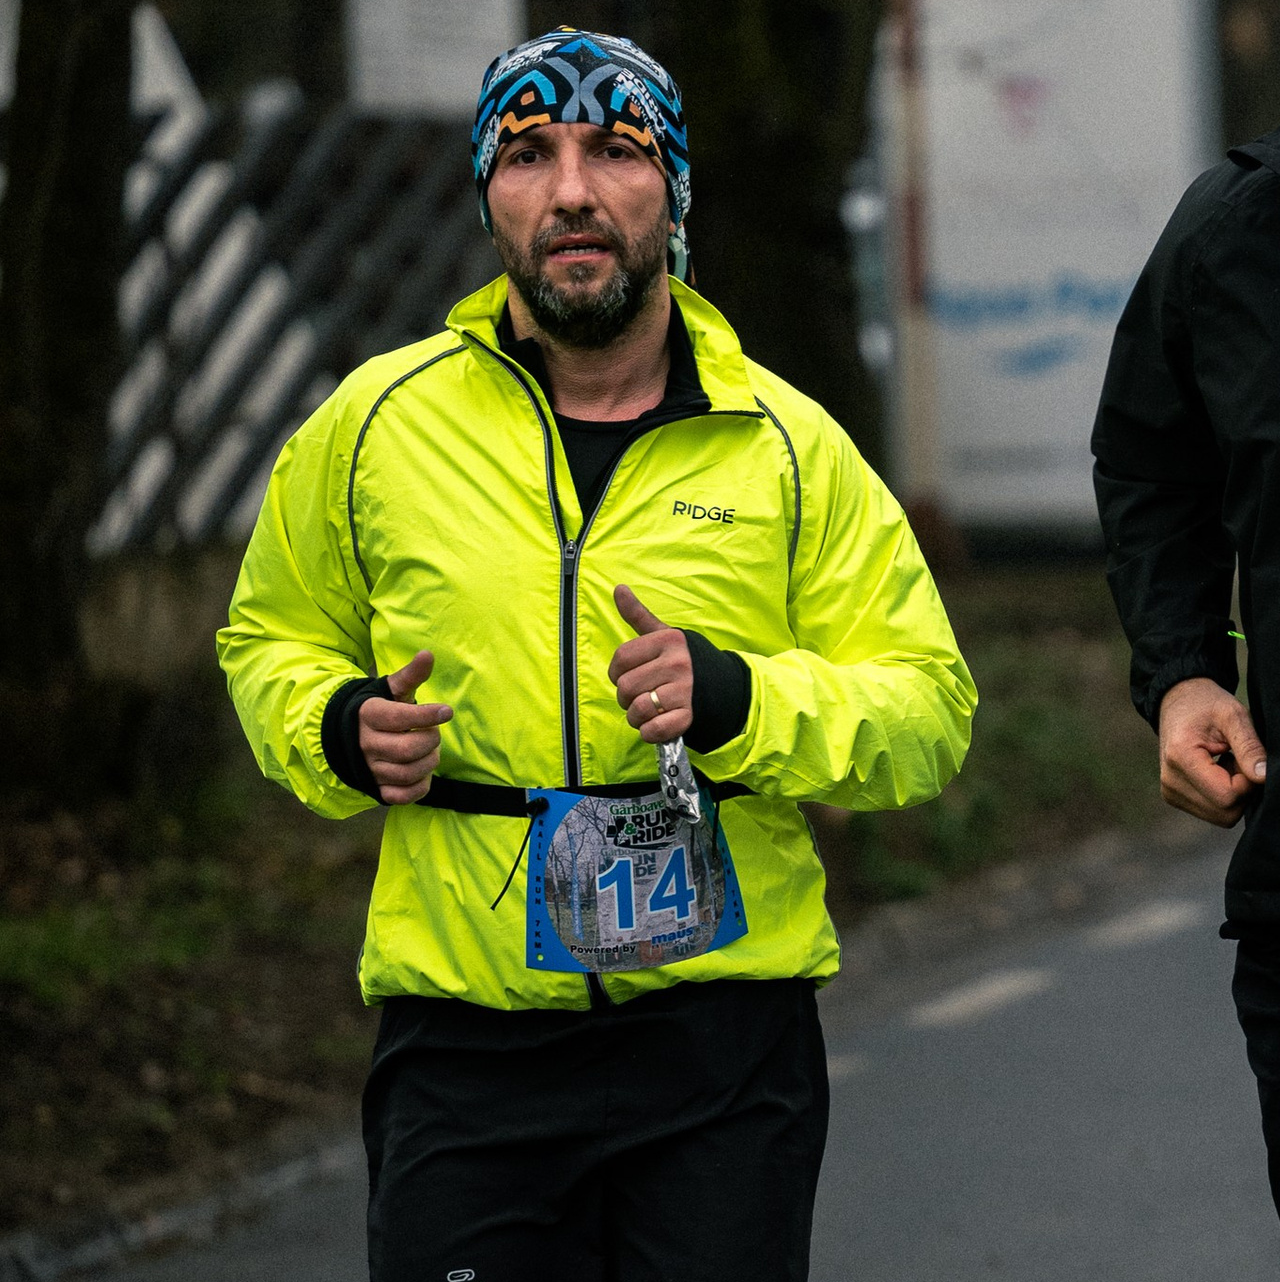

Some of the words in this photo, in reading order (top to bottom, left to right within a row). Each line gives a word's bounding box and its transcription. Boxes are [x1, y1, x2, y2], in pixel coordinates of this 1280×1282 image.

[672, 500, 735, 524] RIDGE
[609, 799, 667, 815] Gârboave
[624, 822, 637, 835] &
[632, 822, 676, 844] RIDE
[597, 844, 698, 932] 14
[534, 919, 542, 949] 7KM
[652, 926, 694, 944] maus
[570, 944, 619, 955] Powered
[623, 944, 636, 955] by
